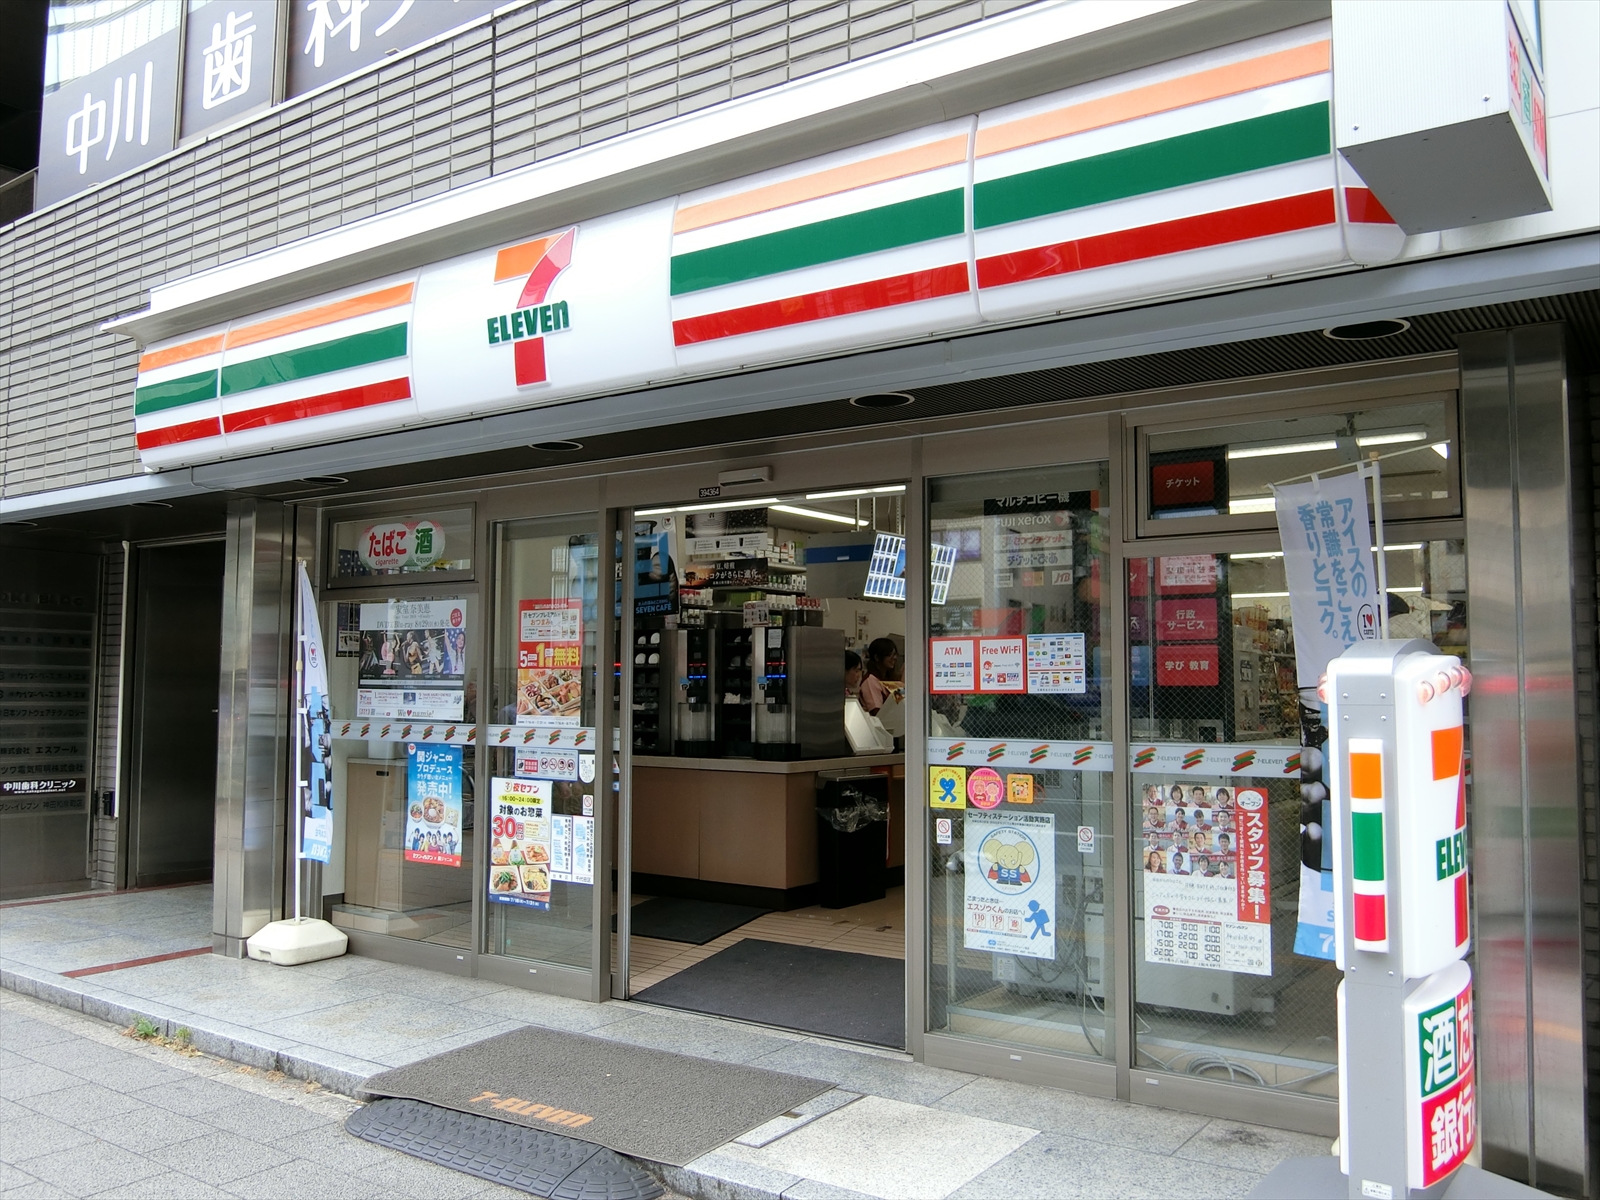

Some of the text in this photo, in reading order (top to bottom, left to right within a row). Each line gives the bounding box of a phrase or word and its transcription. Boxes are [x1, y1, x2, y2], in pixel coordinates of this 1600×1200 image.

[1166, 477, 1201, 489] チケット
[1018, 514, 1052, 526] xerox
[368, 527, 434, 558] たばこ 酒
[1336, 498, 1370, 599] アイスの
[375, 556, 433, 566] cigarette liquor
[1297, 504, 1340, 639] 香りとコク。
[636, 605, 656, 614] SEVEN
[1176, 610, 1195, 620] 行政
[1167, 621, 1205, 630] サービス
[944, 647, 962, 656] ATM
[981, 645, 1021, 655] Free Wi-Fi
[554, 645, 580, 667] 無料
[1165, 661, 1209, 671] 学び 教育
[0, 709, 86, 717] 日本ソフトウェアテクノロジー
[416, 764, 453, 774] プロデュース
[3, 780, 76, 791] 中川歯科クリニック
[416, 781, 453, 799] 発売中!
[513, 783, 539, 793] 夜セブン
[499, 805, 543, 818] 対象のお惣菜
[967, 812, 1051, 824] セーフティステーション活動実施店
[1246, 812, 1266, 920] スタッフ募集!
[1001, 869, 1018, 878] SS
[974, 913, 1003, 923] 110 119
[1422, 1006, 1456, 1092] 酒
[469, 1090, 594, 1128] 7-ELEVEN
[1430, 1084, 1476, 1172] 銀行
